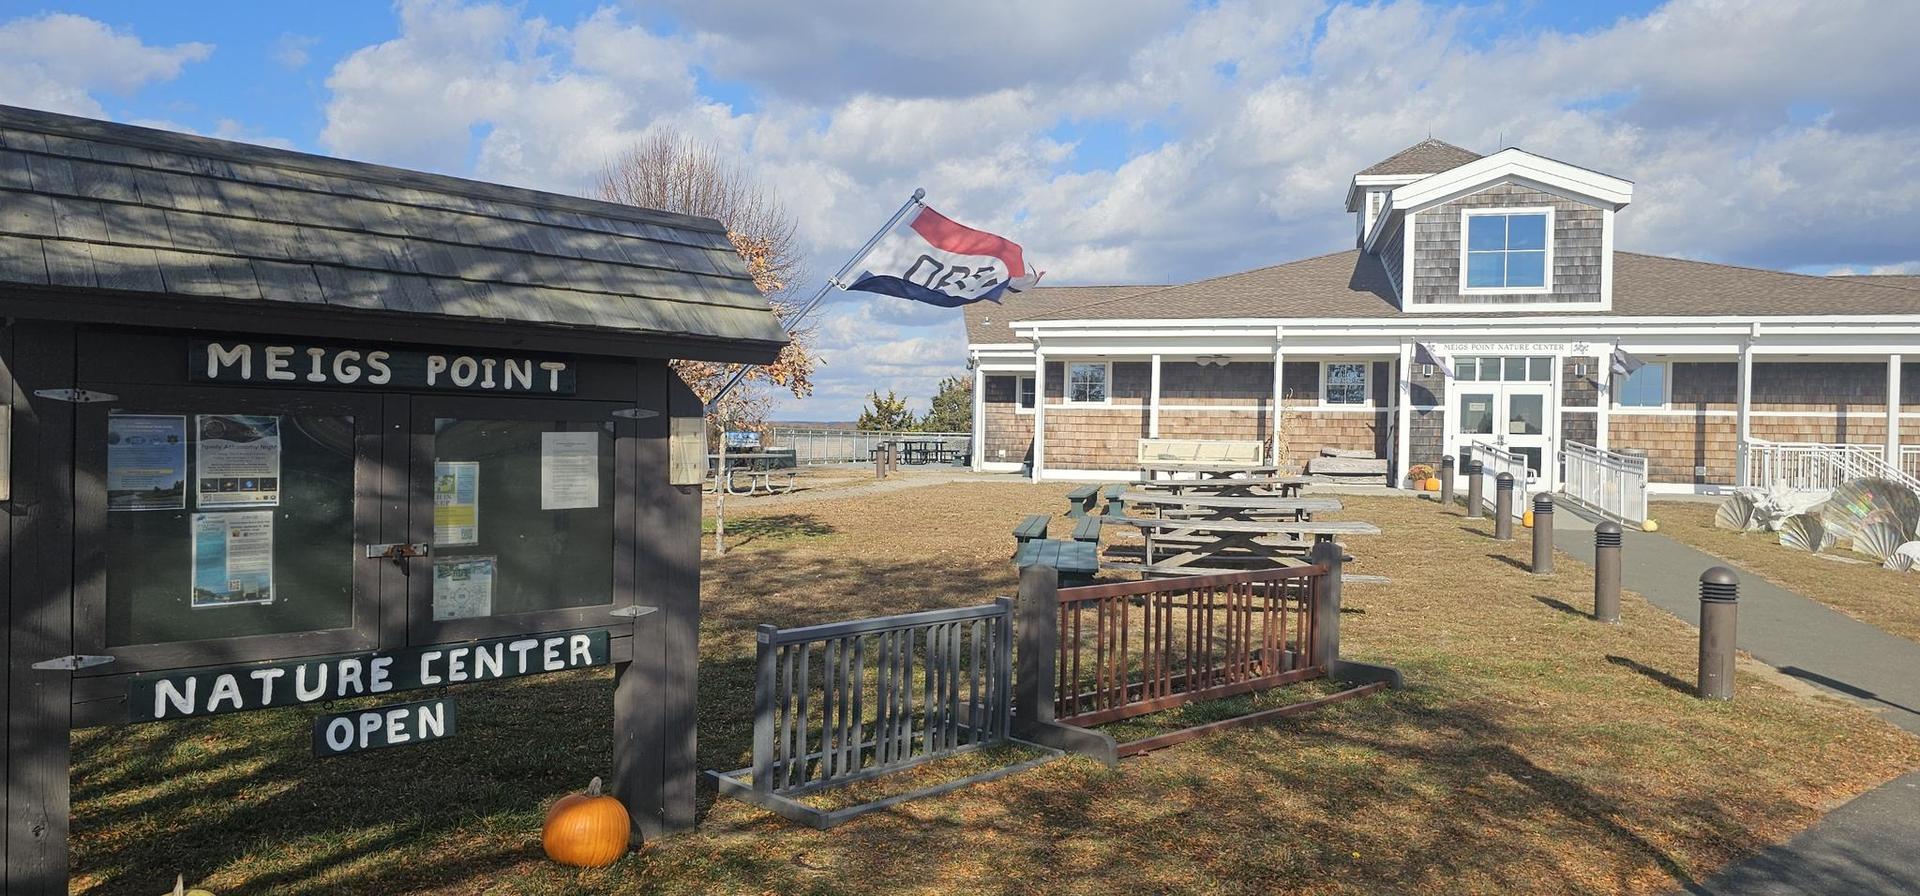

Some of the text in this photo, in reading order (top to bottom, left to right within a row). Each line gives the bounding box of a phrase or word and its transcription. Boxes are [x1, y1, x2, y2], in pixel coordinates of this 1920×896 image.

[903, 254, 999, 292] OPE
[207, 343, 566, 392] MEIGS POINT
[1443, 343, 1565, 351] MEIGS POINT NATURE CENTER
[154, 634, 594, 719] NATURE CENTER
[325, 701, 445, 752] OPEN
